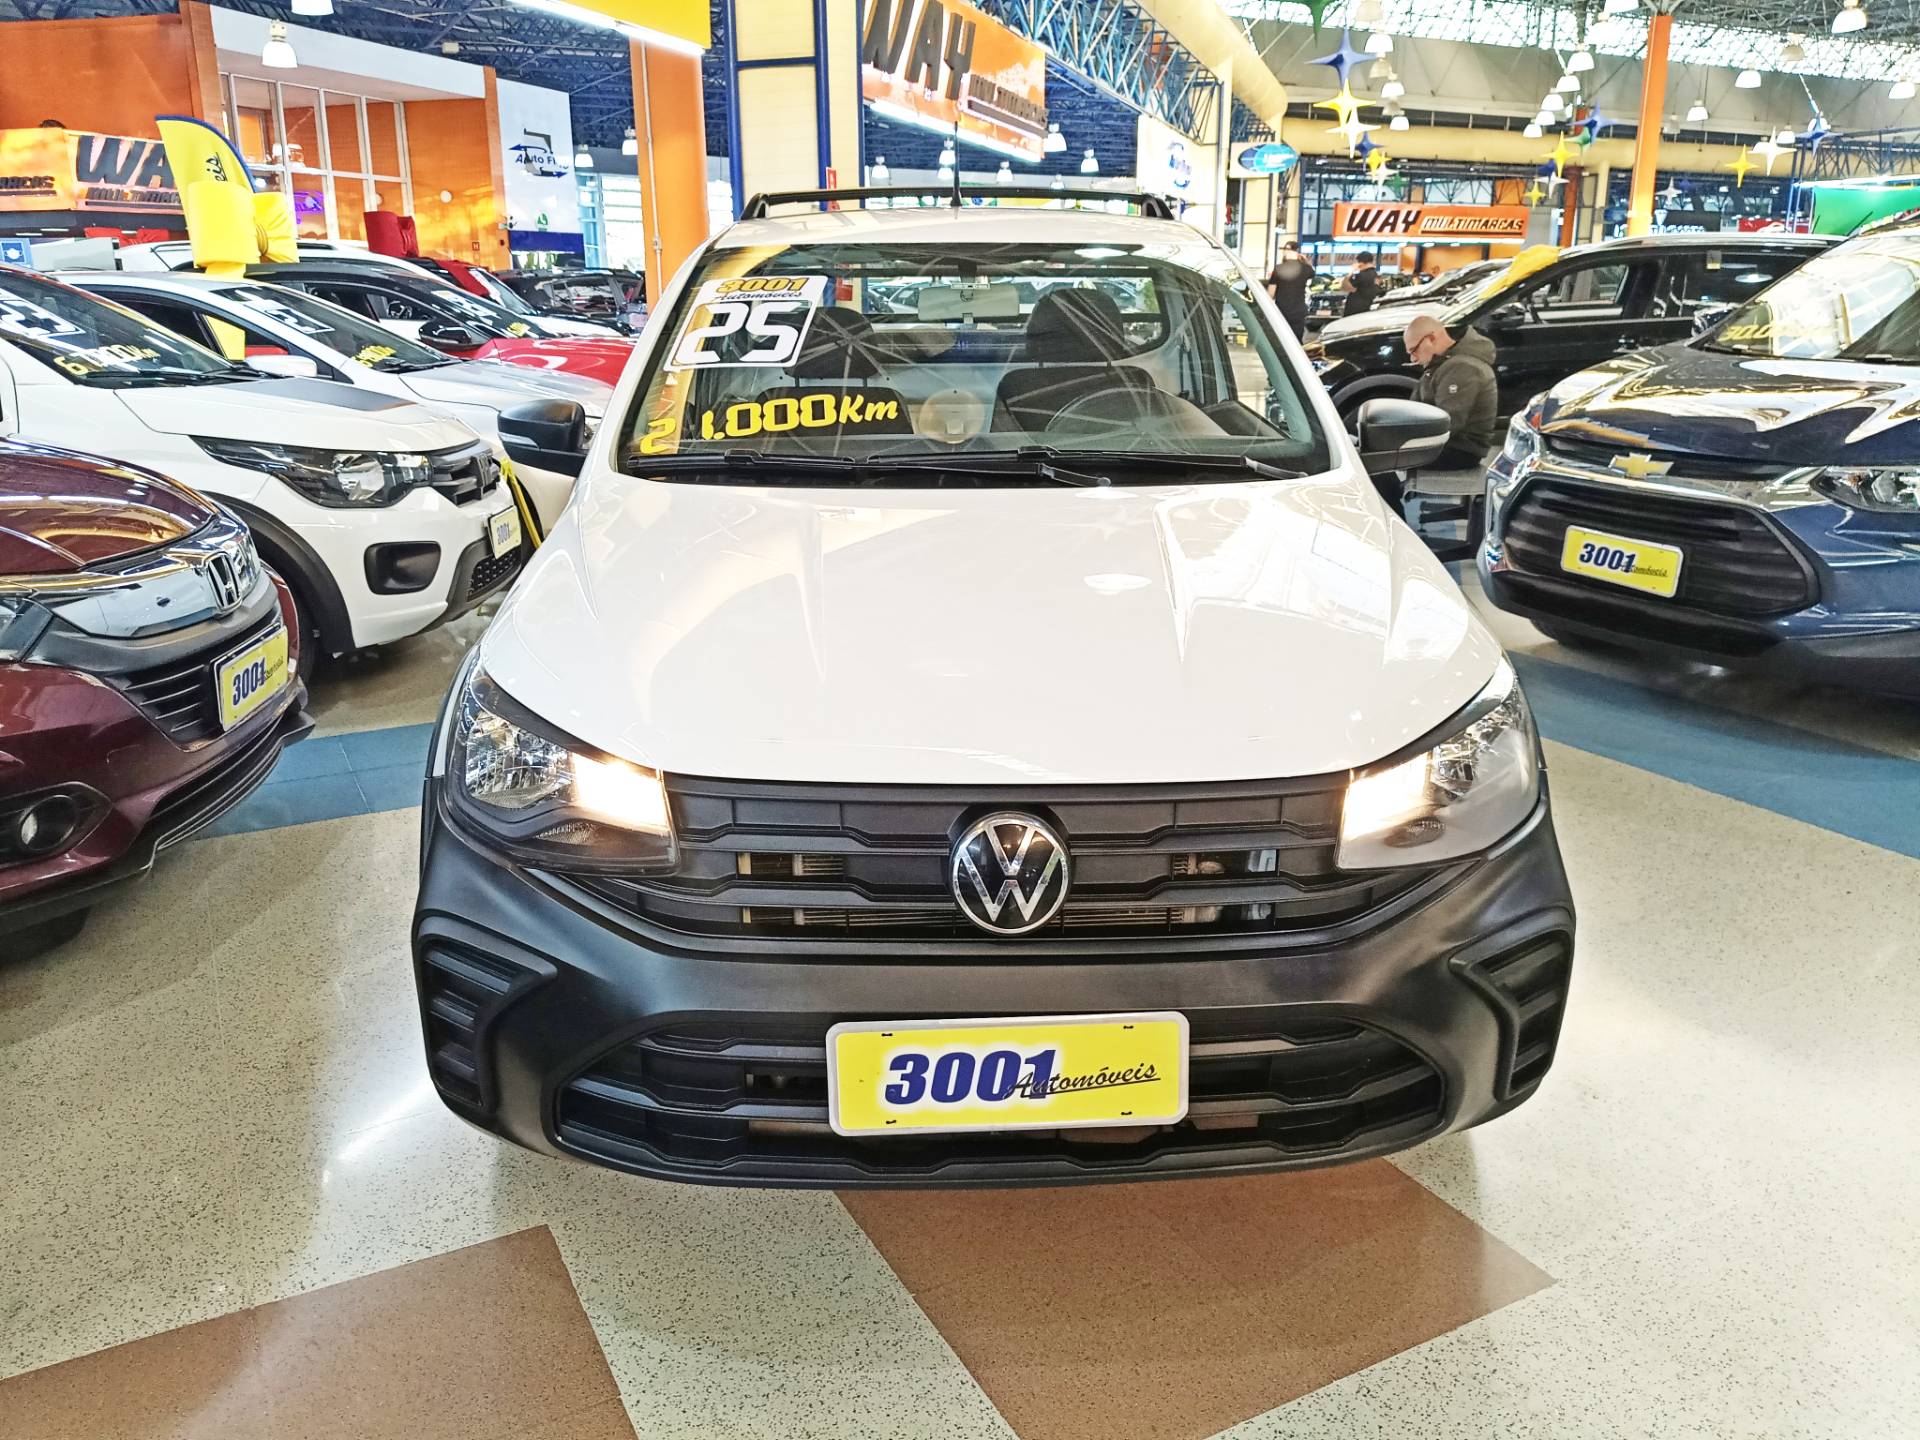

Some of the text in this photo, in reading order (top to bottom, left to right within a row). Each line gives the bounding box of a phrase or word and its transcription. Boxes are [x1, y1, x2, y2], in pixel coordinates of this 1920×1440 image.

[77, 135, 180, 190] WA
[1346, 208, 1523, 233] WAY MULTIMARCAS
[717, 277, 811, 293] 3001
[675, 302, 799, 363] 25
[1579, 542, 1636, 573] 3001
[233, 657, 266, 706] 3001
[885, 1049, 1158, 1105] 3001 Automóveis
